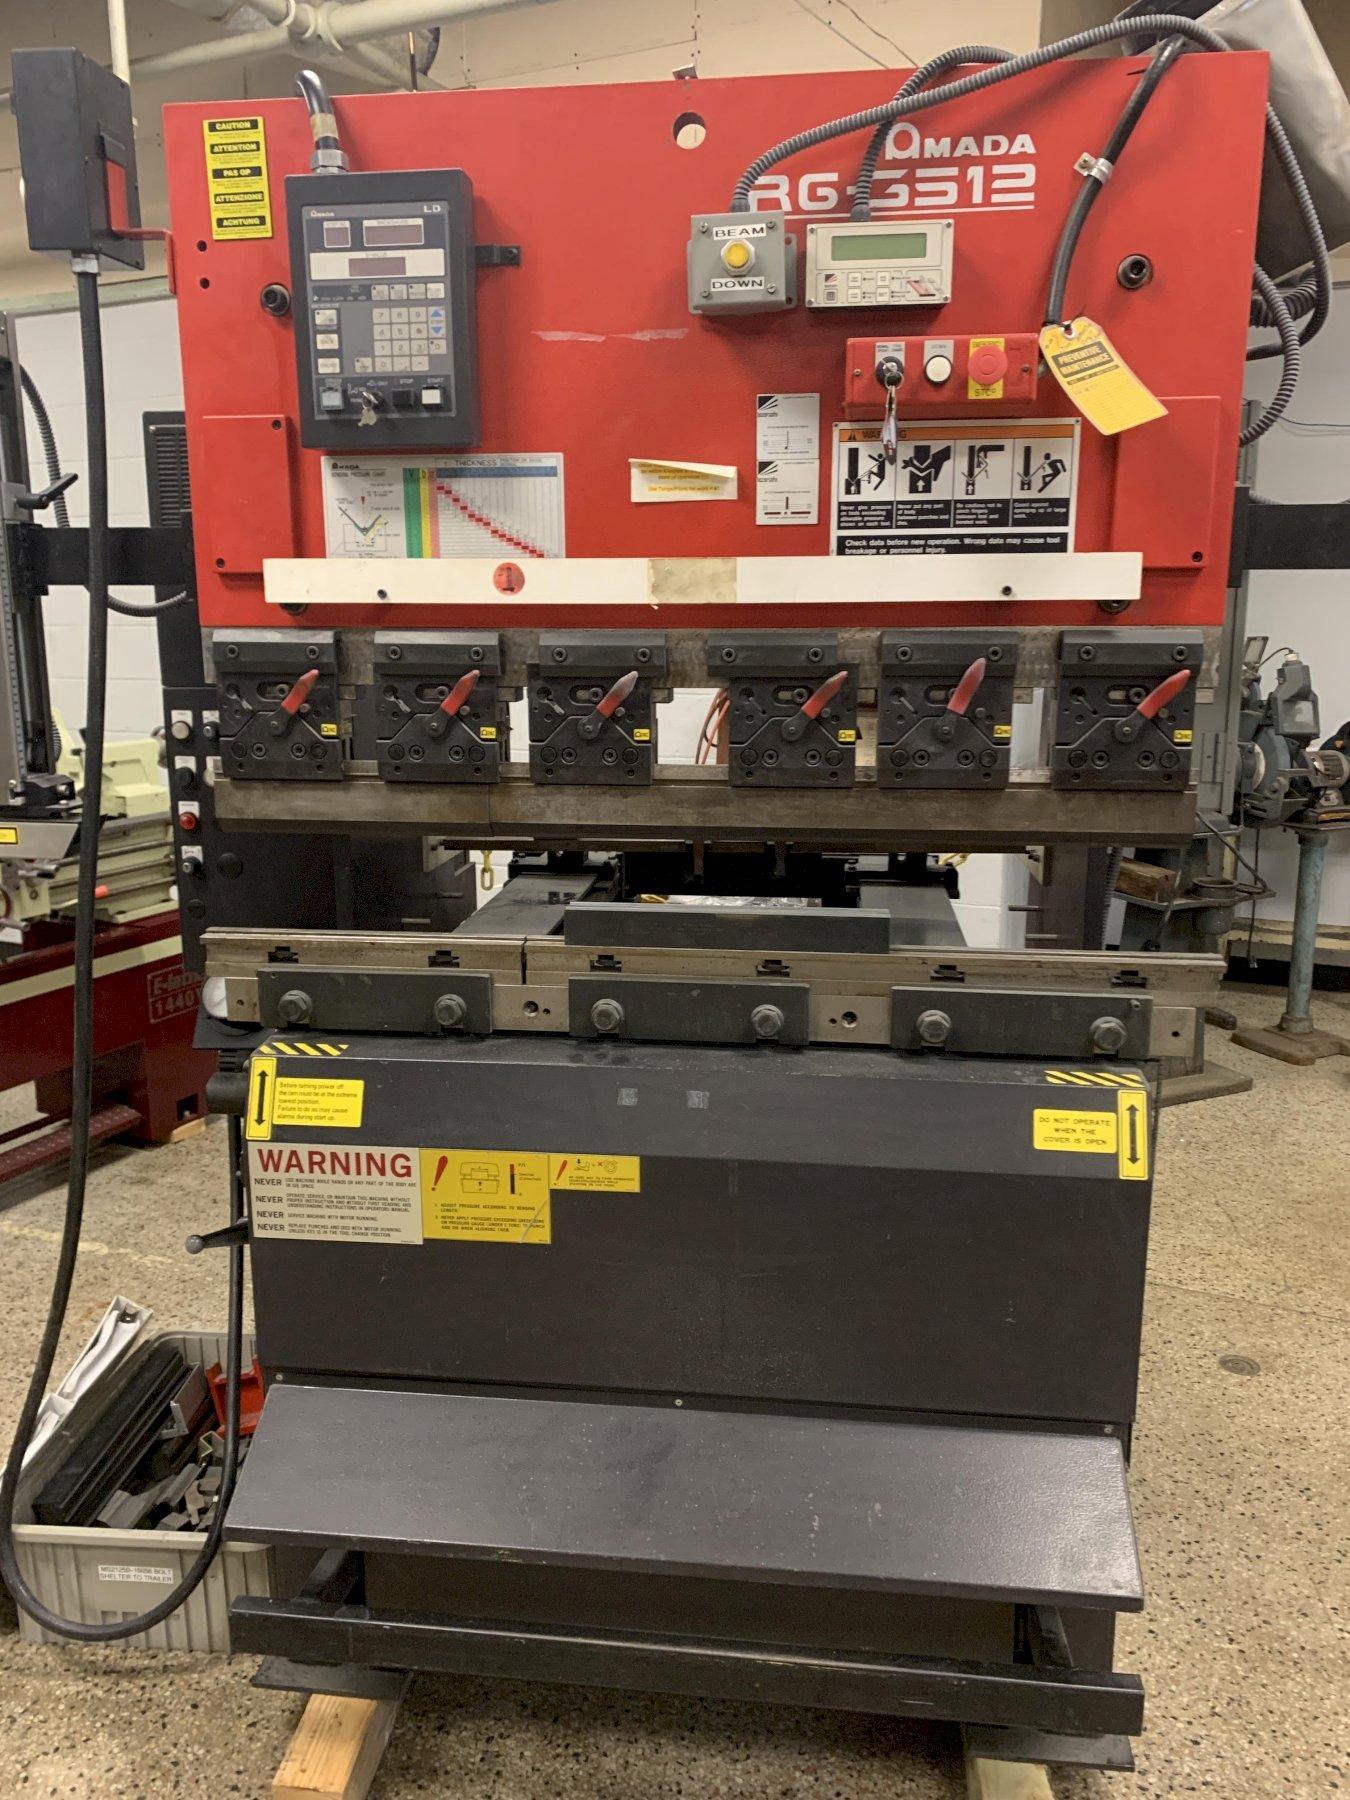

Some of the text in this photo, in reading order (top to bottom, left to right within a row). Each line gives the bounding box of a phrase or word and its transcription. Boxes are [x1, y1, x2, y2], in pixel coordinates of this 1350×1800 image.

[215, 121, 251, 130] CAUTION
[885, 121, 1037, 160] AMADA
[213, 142, 257, 152] ATTENTION
[750, 164, 1036, 212] RG-3512
[216, 192, 263, 202] ATTENZIONE
[424, 205, 441, 213] LD
[222, 218, 260, 226] ACHTUNG
[715, 225, 765, 239] BEAM
[713, 278, 763, 290] DOWN
[862, 430, 906, 439] WARG
[257, 1149, 412, 1178] WARNING
